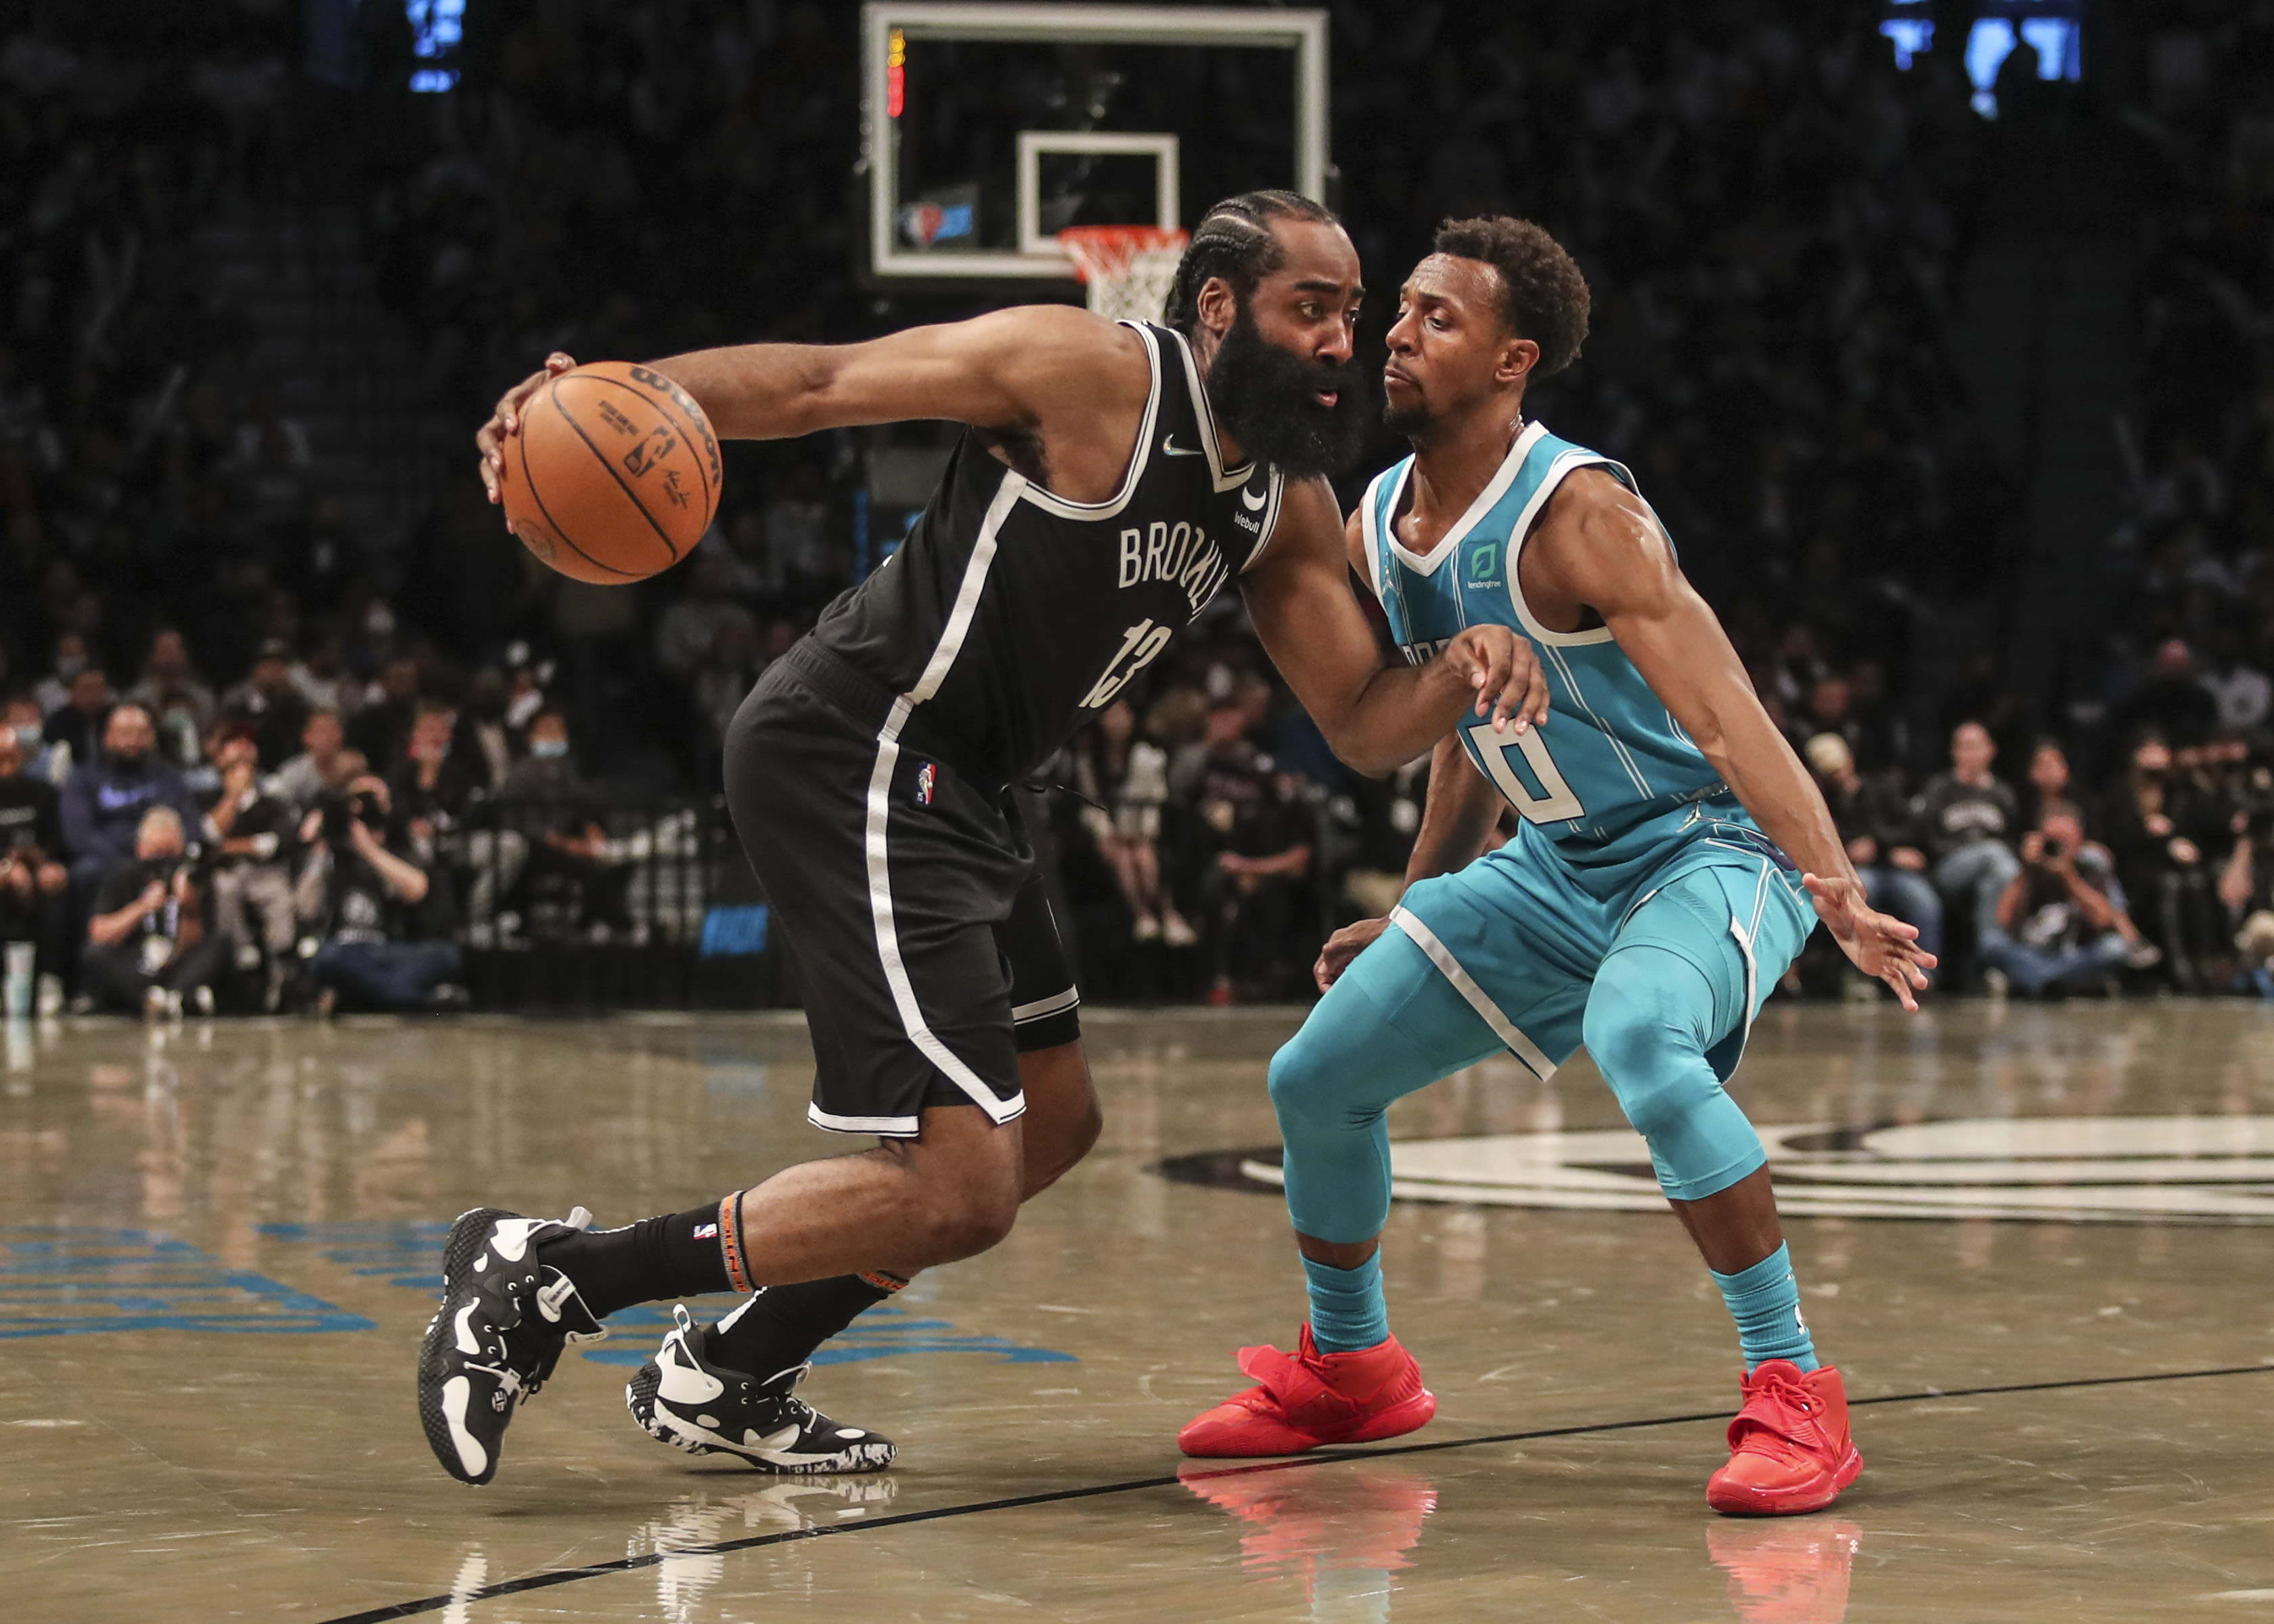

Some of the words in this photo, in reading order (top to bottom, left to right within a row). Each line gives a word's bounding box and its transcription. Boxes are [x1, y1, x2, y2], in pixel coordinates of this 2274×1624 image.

[1234, 511, 1260, 534] Webull
[1467, 580, 1502, 589] lendingtree
[1079, 618, 1172, 708] 13
[1468, 717, 1586, 825] 0
